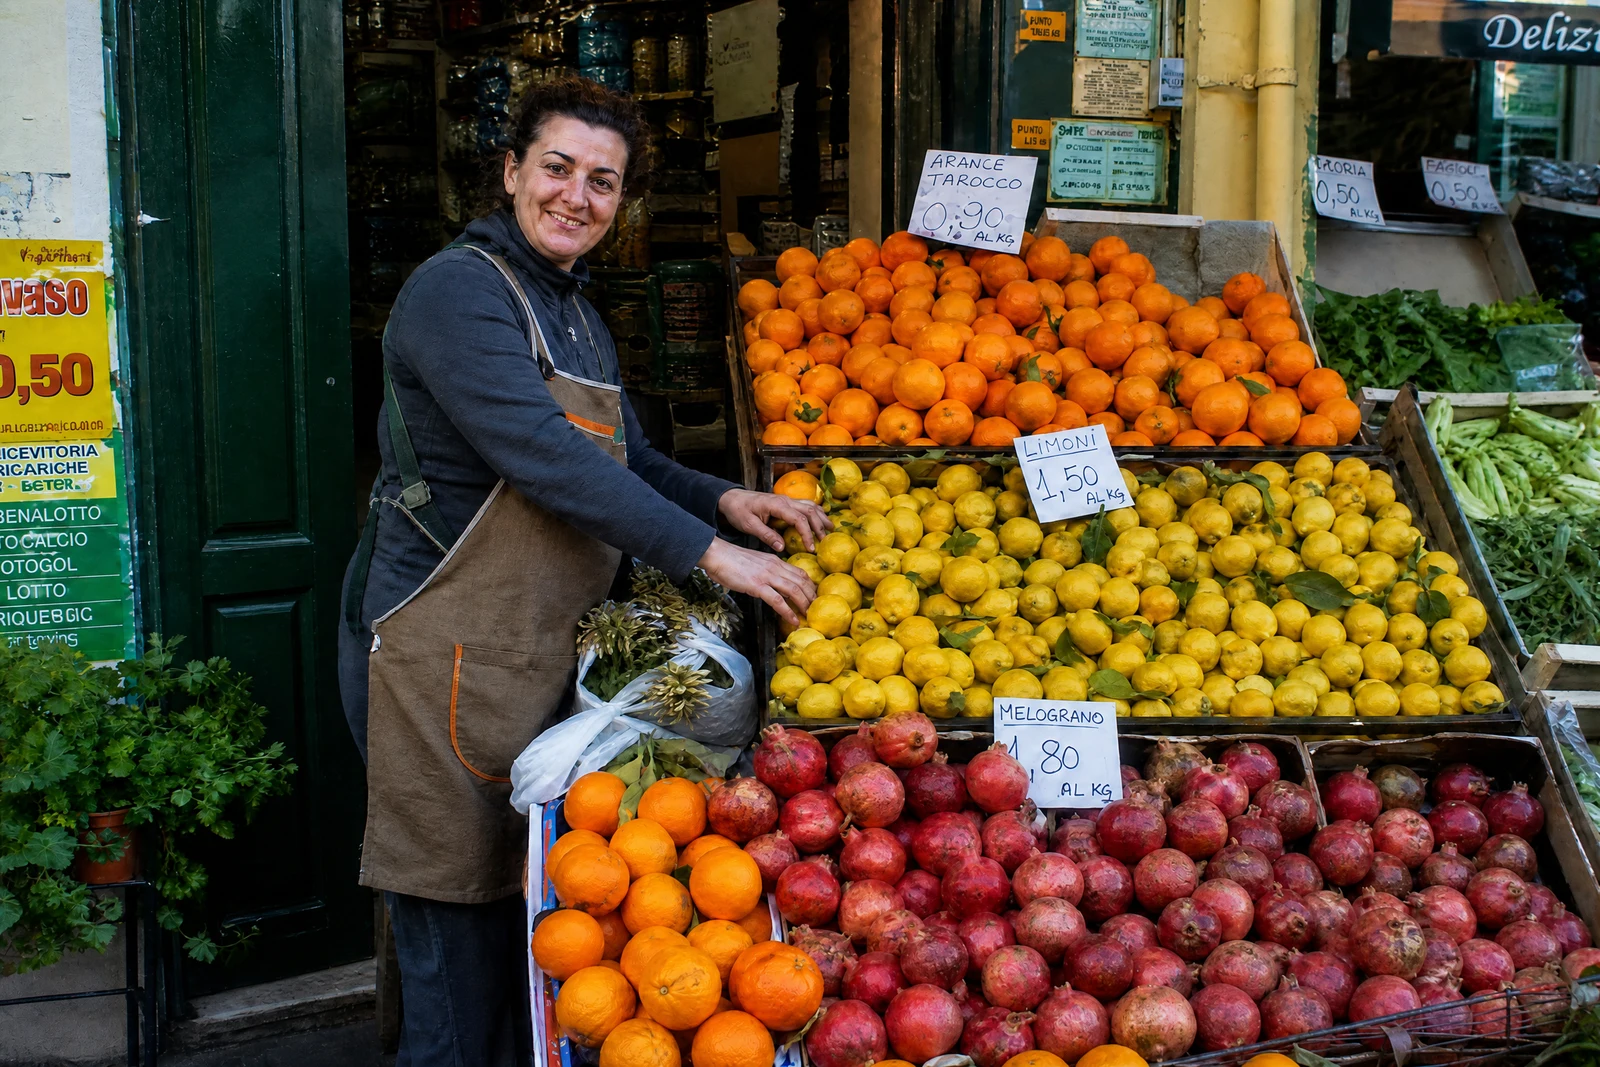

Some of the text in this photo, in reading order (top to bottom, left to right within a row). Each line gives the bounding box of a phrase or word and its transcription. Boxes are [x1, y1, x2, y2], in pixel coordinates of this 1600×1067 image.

[1017, 124, 1043, 135] PUNTO
[930, 154, 1005, 171] ARANCE
[927, 173, 1023, 190] TAROCCO
[1316, 180, 1360, 209] 0,50
[1431, 181, 1479, 206] 0,50
[922, 201, 1004, 237] 0,90
[974, 231, 1015, 247] AL KG
[0, 279, 89, 317] vaso
[0, 444, 99, 460] ICEVITORIA
[1036, 464, 1099, 503] 1,50
[1086, 488, 1126, 505] AL KG
[0, 557, 78, 575] OTOGOL
[6, 583, 67, 600] LOTTO
[1000, 703, 1104, 725] MELOGRANO
[1008, 735, 1079, 784] 1,80
[1091, 783, 1114, 803] KG
